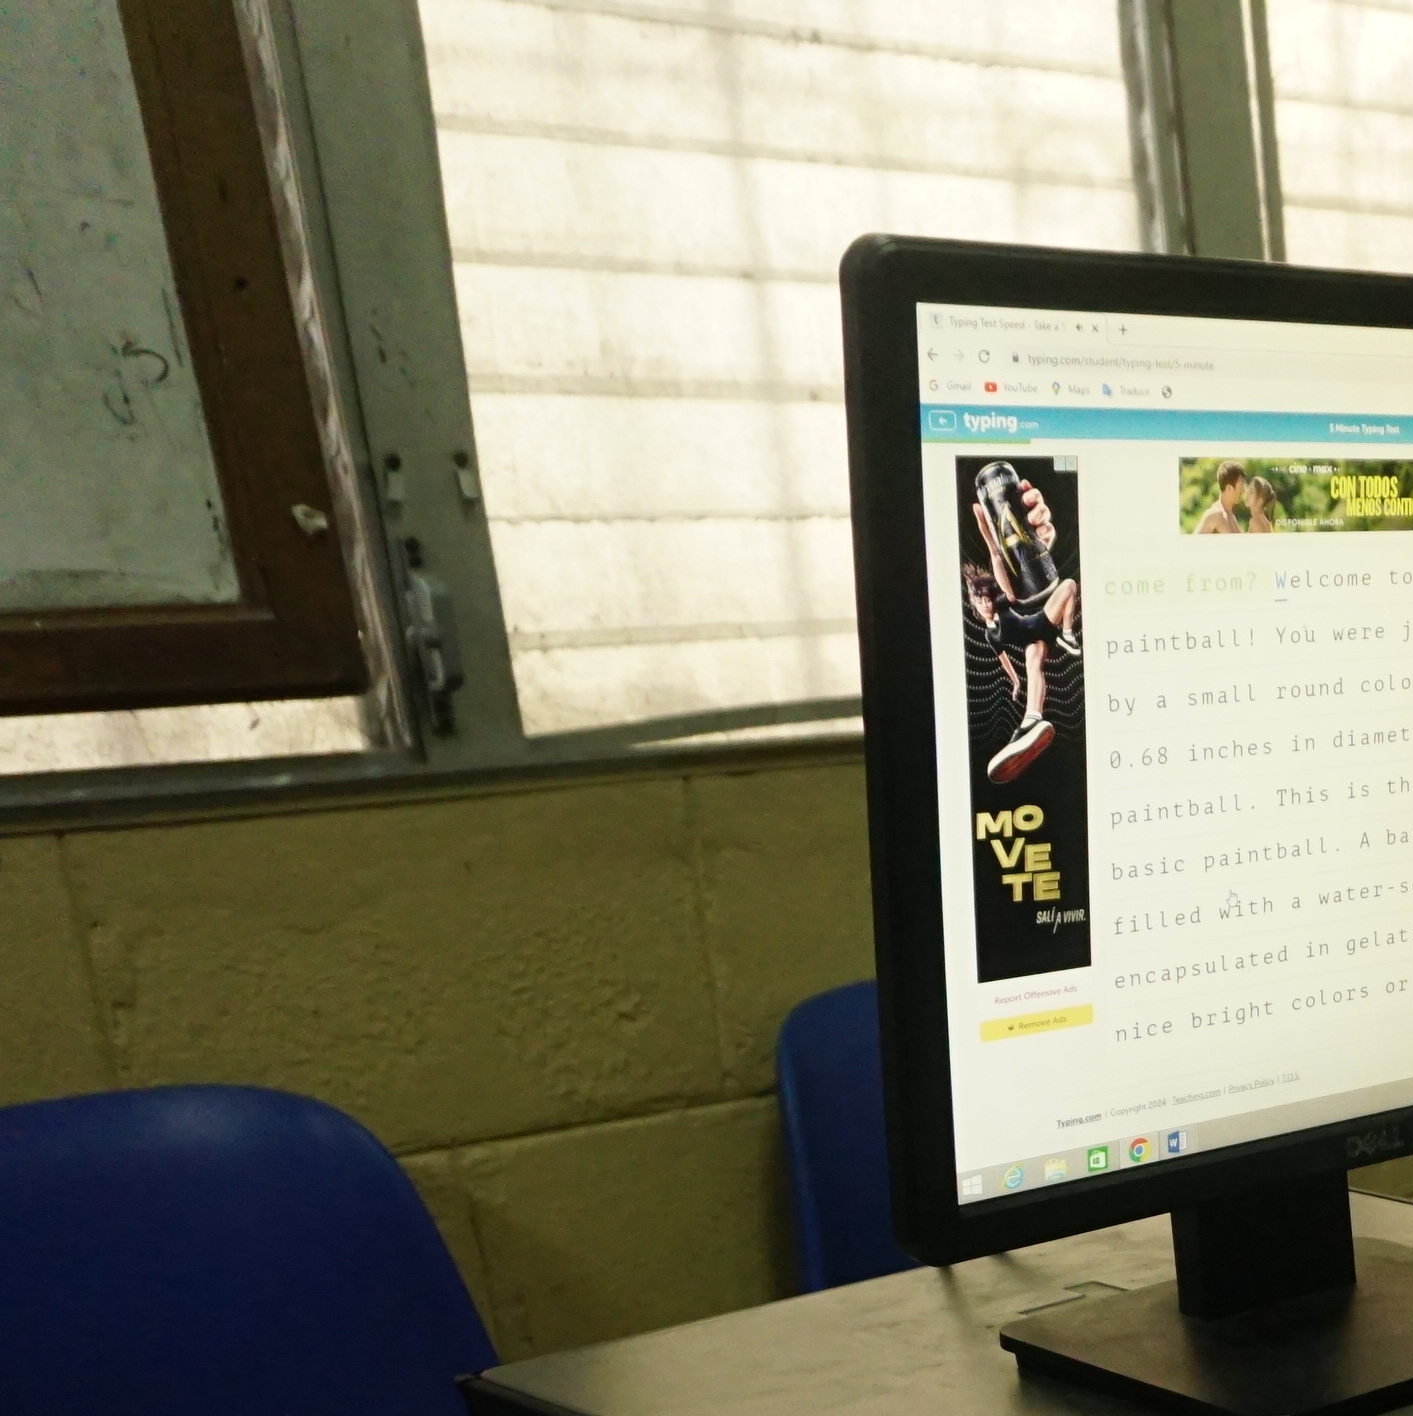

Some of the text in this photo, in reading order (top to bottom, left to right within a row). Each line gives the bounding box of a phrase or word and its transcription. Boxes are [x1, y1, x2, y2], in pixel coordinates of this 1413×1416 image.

[949, 315, 978, 330] Typing
[980, 317, 998, 328] Test
[999, 318, 1026, 332] Speed
[946, 380, 972, 392] Gmail
[1003, 382, 1038, 394] YouTube
[1068, 384, 1090, 396] Maps
[1335, 423, 1360, 433] Minute
[1361, 423, 1385, 436] Typing
[1386, 424, 1400, 434] Test
[1331, 475, 1398, 498] CON TODOS
[1275, 518, 1344, 527] DISPONIBLE AHORA
[1346, 497, 1382, 516] MENOS
[1104, 578, 1166, 597] come
[1185, 570, 1258, 594] from?
[1274, 569, 1372, 590] Welcome
[1388, 569, 1413, 586] to
[1106, 627, 1254, 660] paintball!
[1275, 625, 1316, 645] You
[1332, 625, 1385, 642] were
[1108, 693, 1136, 717] by
[1156, 694, 1168, 710] a
[1187, 682, 1256, 707] small
[1276, 676, 1345, 701] round
[1109, 745, 1169, 770] 0.68
[1188, 739, 1273, 763] inches
[1291, 733, 1316, 753] in
[1110, 793, 1256, 830] paintball.
[1275, 785, 1329, 808] This
[1347, 781, 1370, 800] is
[976, 804, 1044, 840] MO
[990, 837, 1051, 872] VE
[1111, 856, 1185, 881] basic
[1203, 836, 1340, 874] paintball.
[1359, 831, 1371, 850] A
[1002, 872, 1061, 902] TE
[1036, 906, 1055, 924] SALÍ
[1053, 911, 1062, 934] A
[1114, 905, 1202, 936] filled
[1218, 892, 1274, 921] with
[1290, 895, 1302, 910] a
[1114, 944, 1289, 990] encapsulated
[1306, 940, 1330, 959] in
[994, 985, 1078, 1005] Report Offensive Ads
[1115, 1020, 1173, 1043] nice
[1190, 1000, 1274, 1030] bright
[1291, 985, 1370, 1012] colors
[1384, 978, 1409, 995] or
[1018, 1016, 1067, 1031] Remove Ads
[1056, 1112, 1102, 1130] Typing.com
[1110, 1103, 1147, 1118] Copyright
[1148, 1098, 1167, 1110] 2024
[1171, 1088, 1221, 1105] Teaching.com
[1228, 1082, 1254, 1095] Privacy
[1255, 1078, 1275, 1091] Policy
